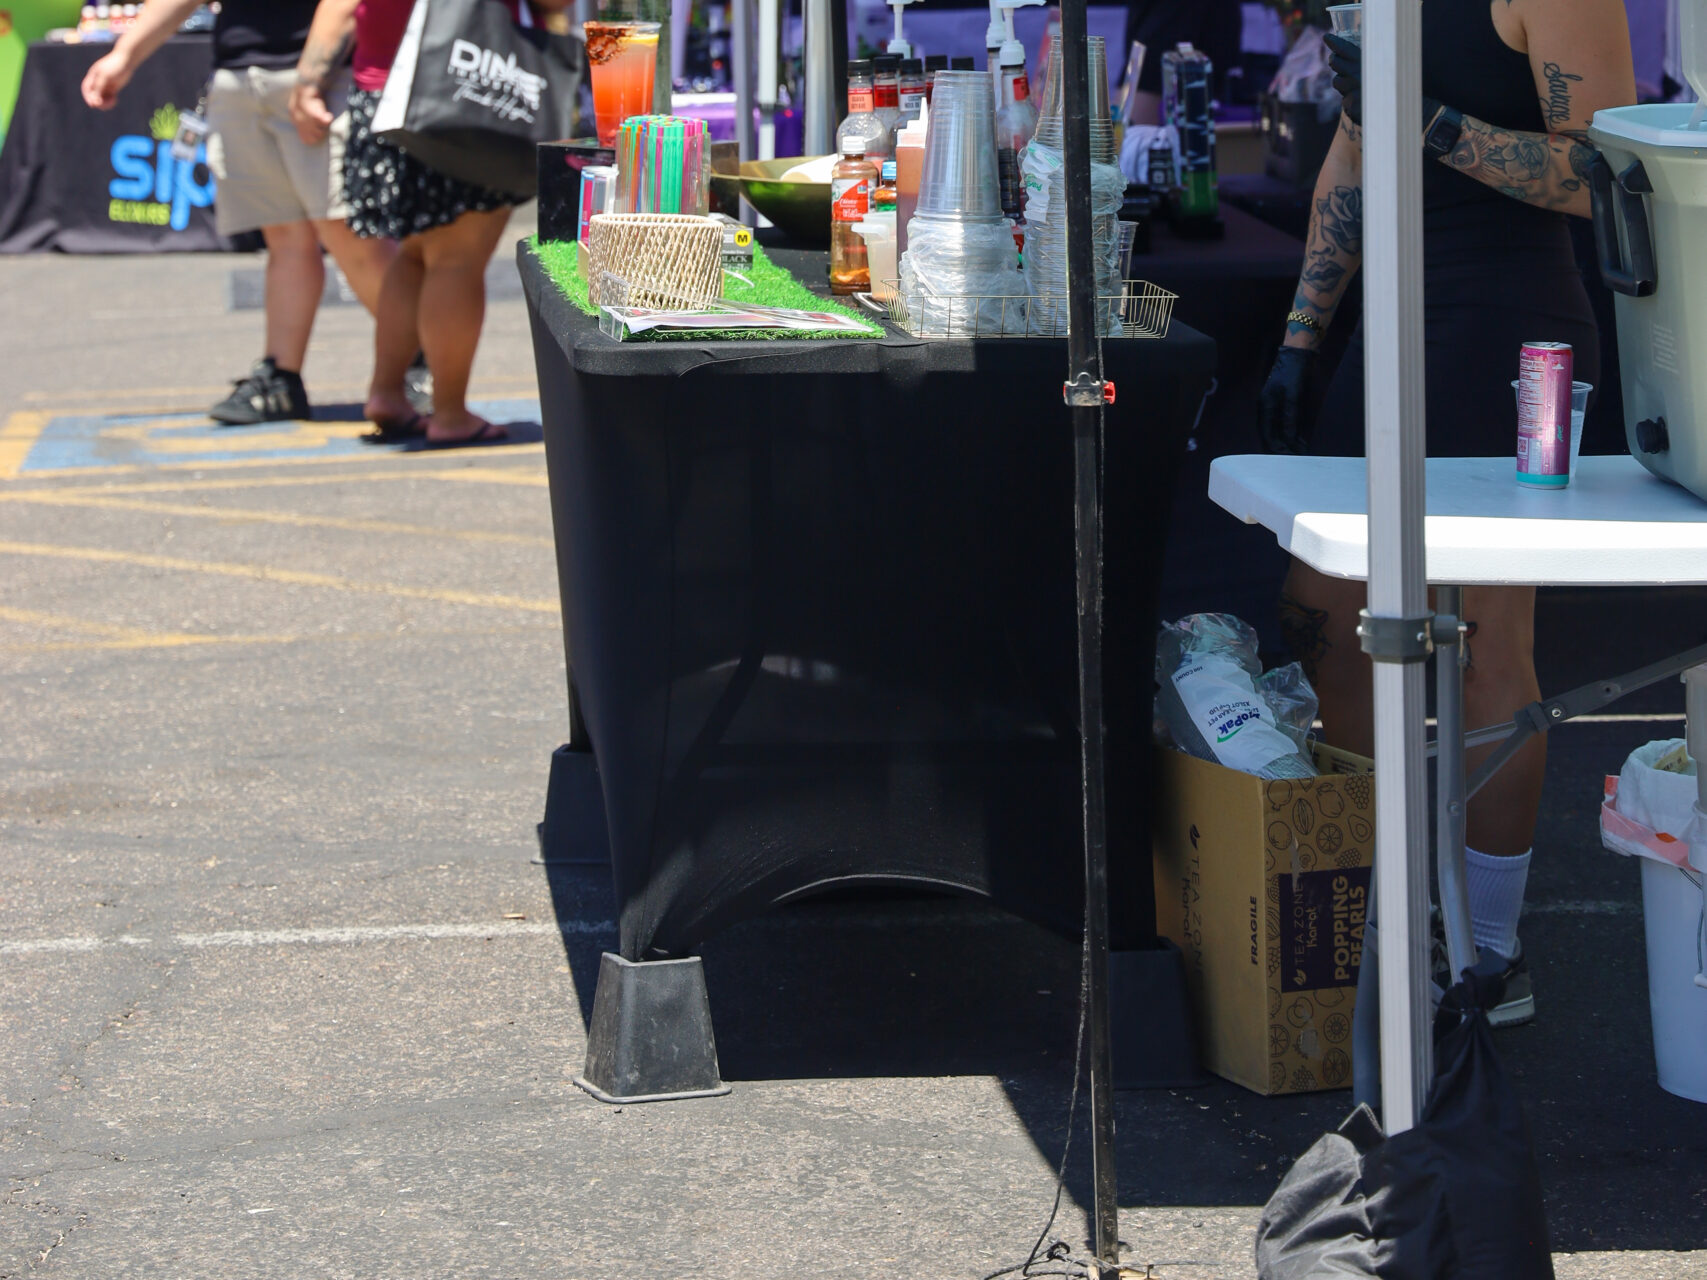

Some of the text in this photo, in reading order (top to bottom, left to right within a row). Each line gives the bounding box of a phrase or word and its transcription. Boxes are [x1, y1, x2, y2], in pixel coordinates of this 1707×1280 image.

[737, 234, 748, 243] M
[1249, 895, 1258, 966] FRAGILE
[1294, 934, 1305, 966] TEA
[1332, 875, 1350, 981] POPPING
[1348, 885, 1366, 967] PEARLS
